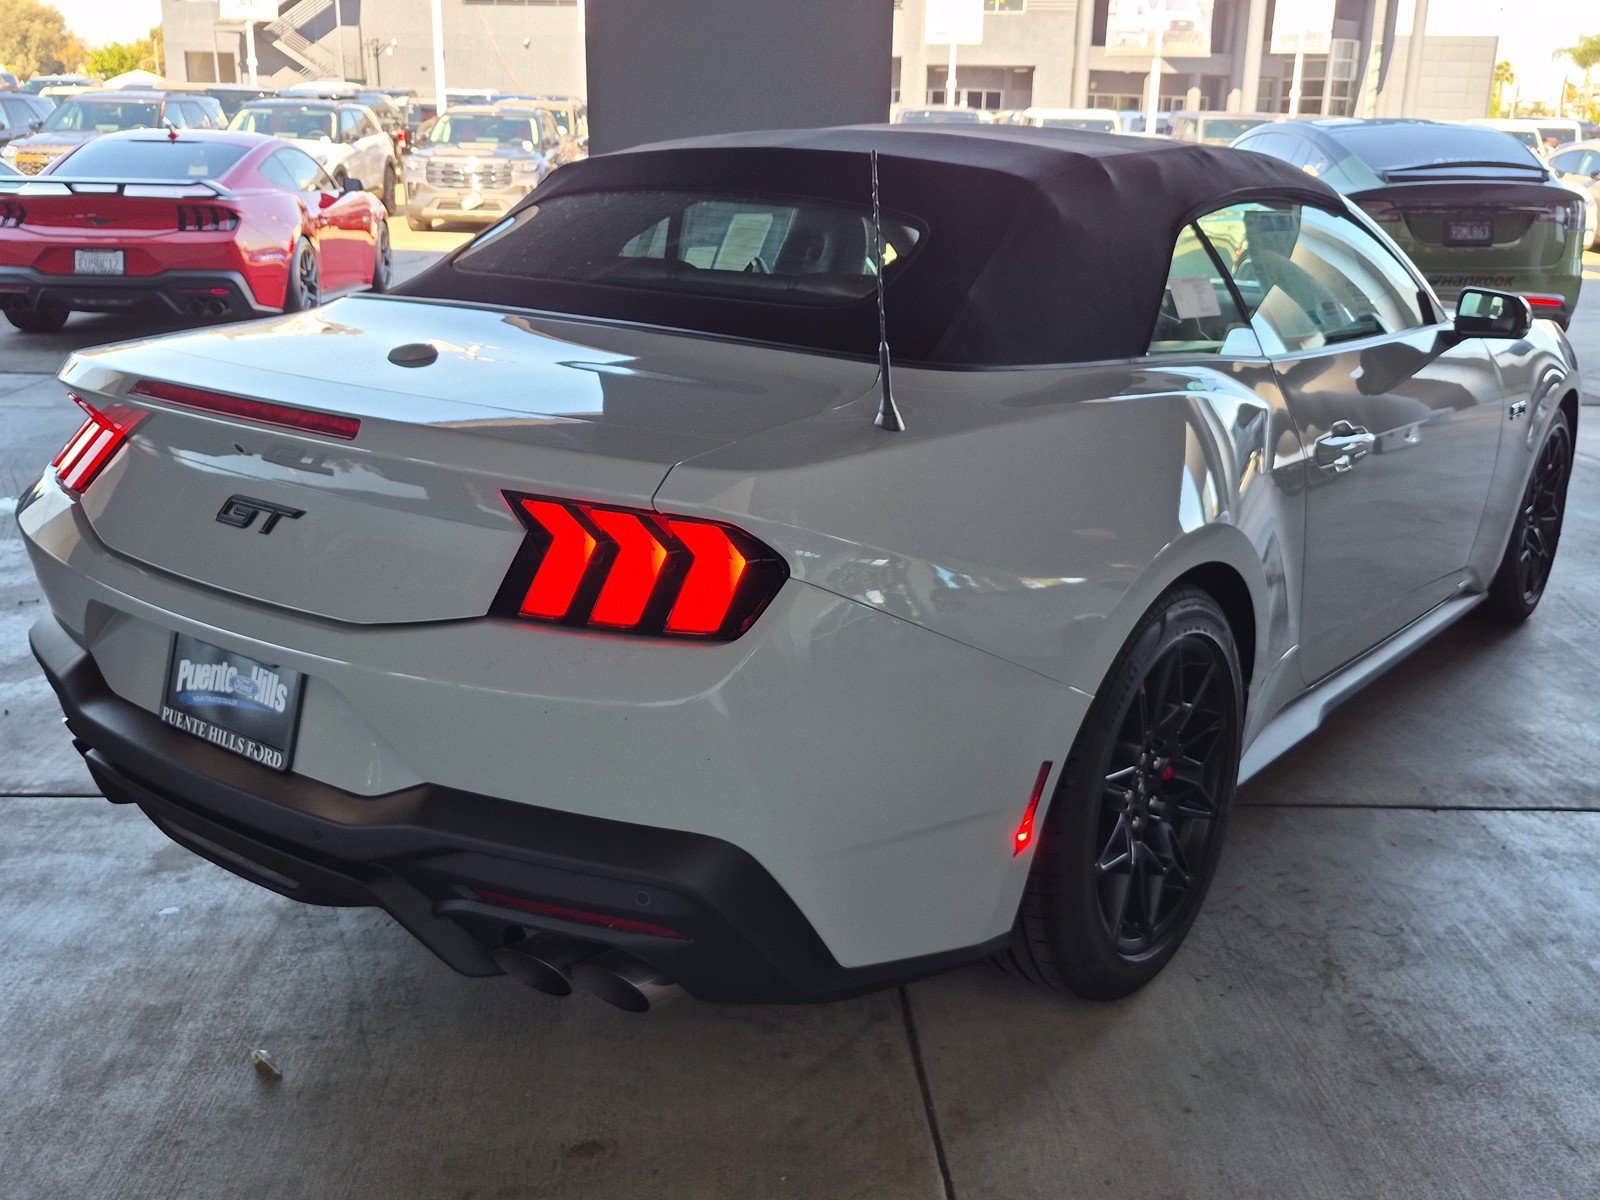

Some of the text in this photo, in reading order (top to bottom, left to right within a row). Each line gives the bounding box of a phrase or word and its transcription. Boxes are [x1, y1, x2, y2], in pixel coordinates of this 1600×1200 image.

[215, 493, 307, 535] GT
[176, 659, 288, 714] Puente Hills
[162, 705, 283, 769] PUENTE HILLS FORD
